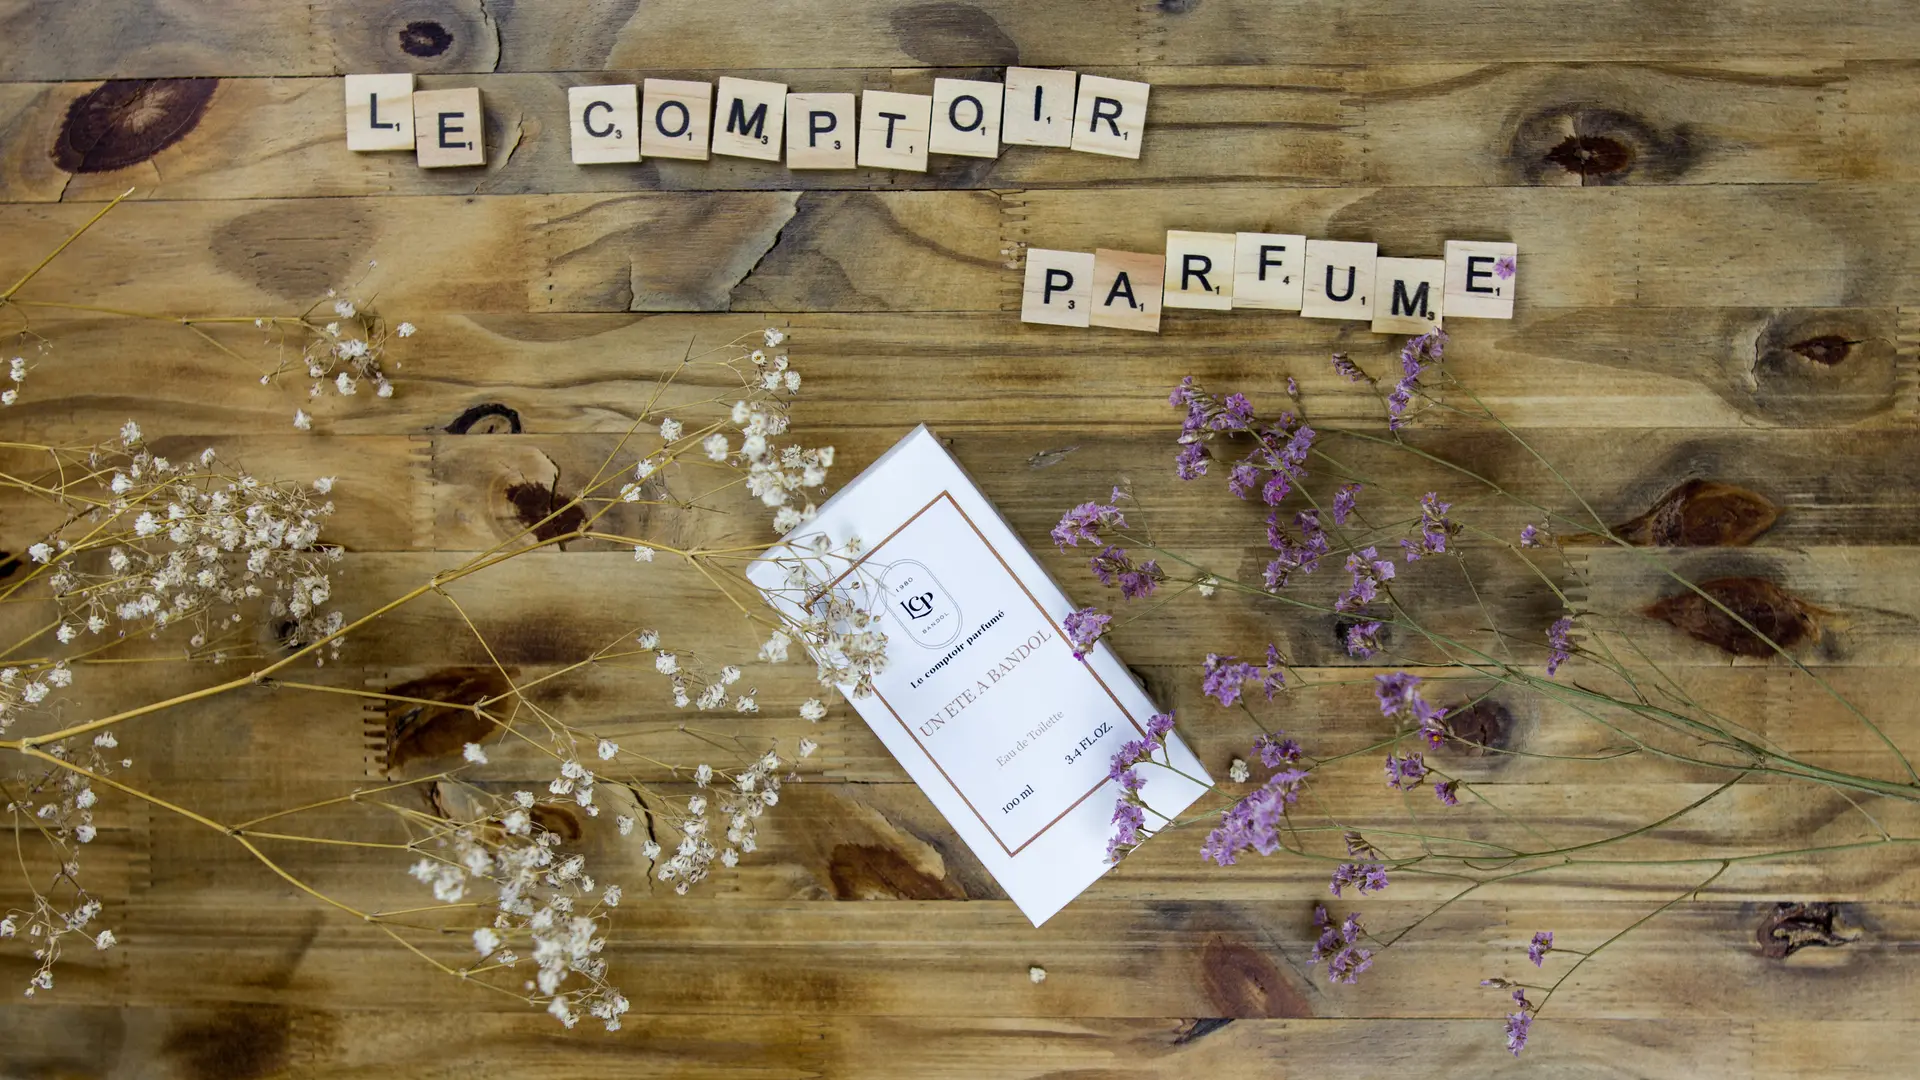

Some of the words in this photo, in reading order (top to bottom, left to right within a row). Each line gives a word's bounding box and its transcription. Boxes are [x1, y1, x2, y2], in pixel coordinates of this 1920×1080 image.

[369, 93, 466, 149] LE
[583, 85, 1123, 149] COMPTOIR
[1043, 245, 1495, 318] PARFUME
[895, 576, 914, 593] 1980
[910, 677, 924, 689] Le
[924, 642, 965, 678] comptoir
[966, 609, 1005, 646] parfumé
[922, 612, 950, 635] BANDOL
[919, 711, 946, 737] UN
[943, 687, 977, 720] ETE
[976, 679, 990, 695] A
[986, 629, 1052, 684] BANDOL
[996, 751, 1017, 767] Eau
[1016, 738, 1030, 752] de
[1026, 710, 1065, 742] Toilette
[1064, 748, 1083, 765] 3.4
[1001, 796, 1021, 815] 100
[1020, 784, 1035, 800] ml
